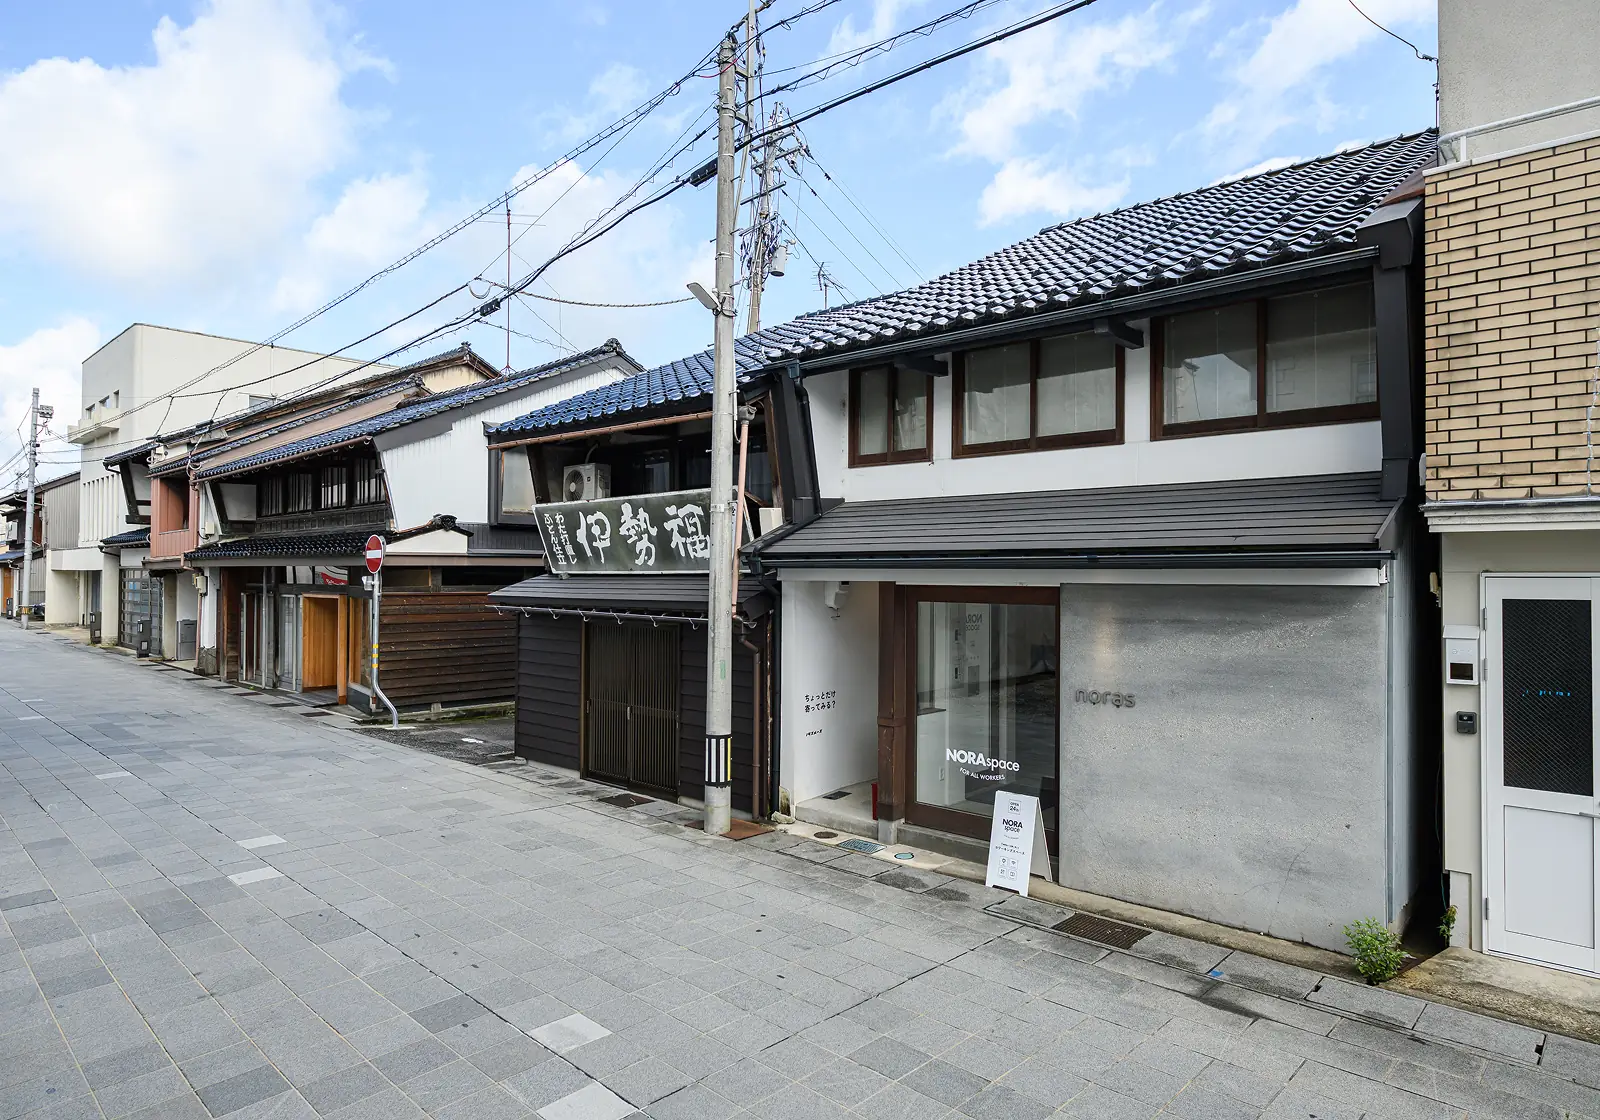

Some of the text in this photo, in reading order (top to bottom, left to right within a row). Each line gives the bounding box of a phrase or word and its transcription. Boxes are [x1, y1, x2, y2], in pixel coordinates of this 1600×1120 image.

[804, 690, 836, 702] ちょっとだけ
[1075, 689, 1136, 708] noras
[960, 767, 970, 776] FOR
[1002, 818, 1023, 829] NORA
[1004, 825, 1021, 833] space
